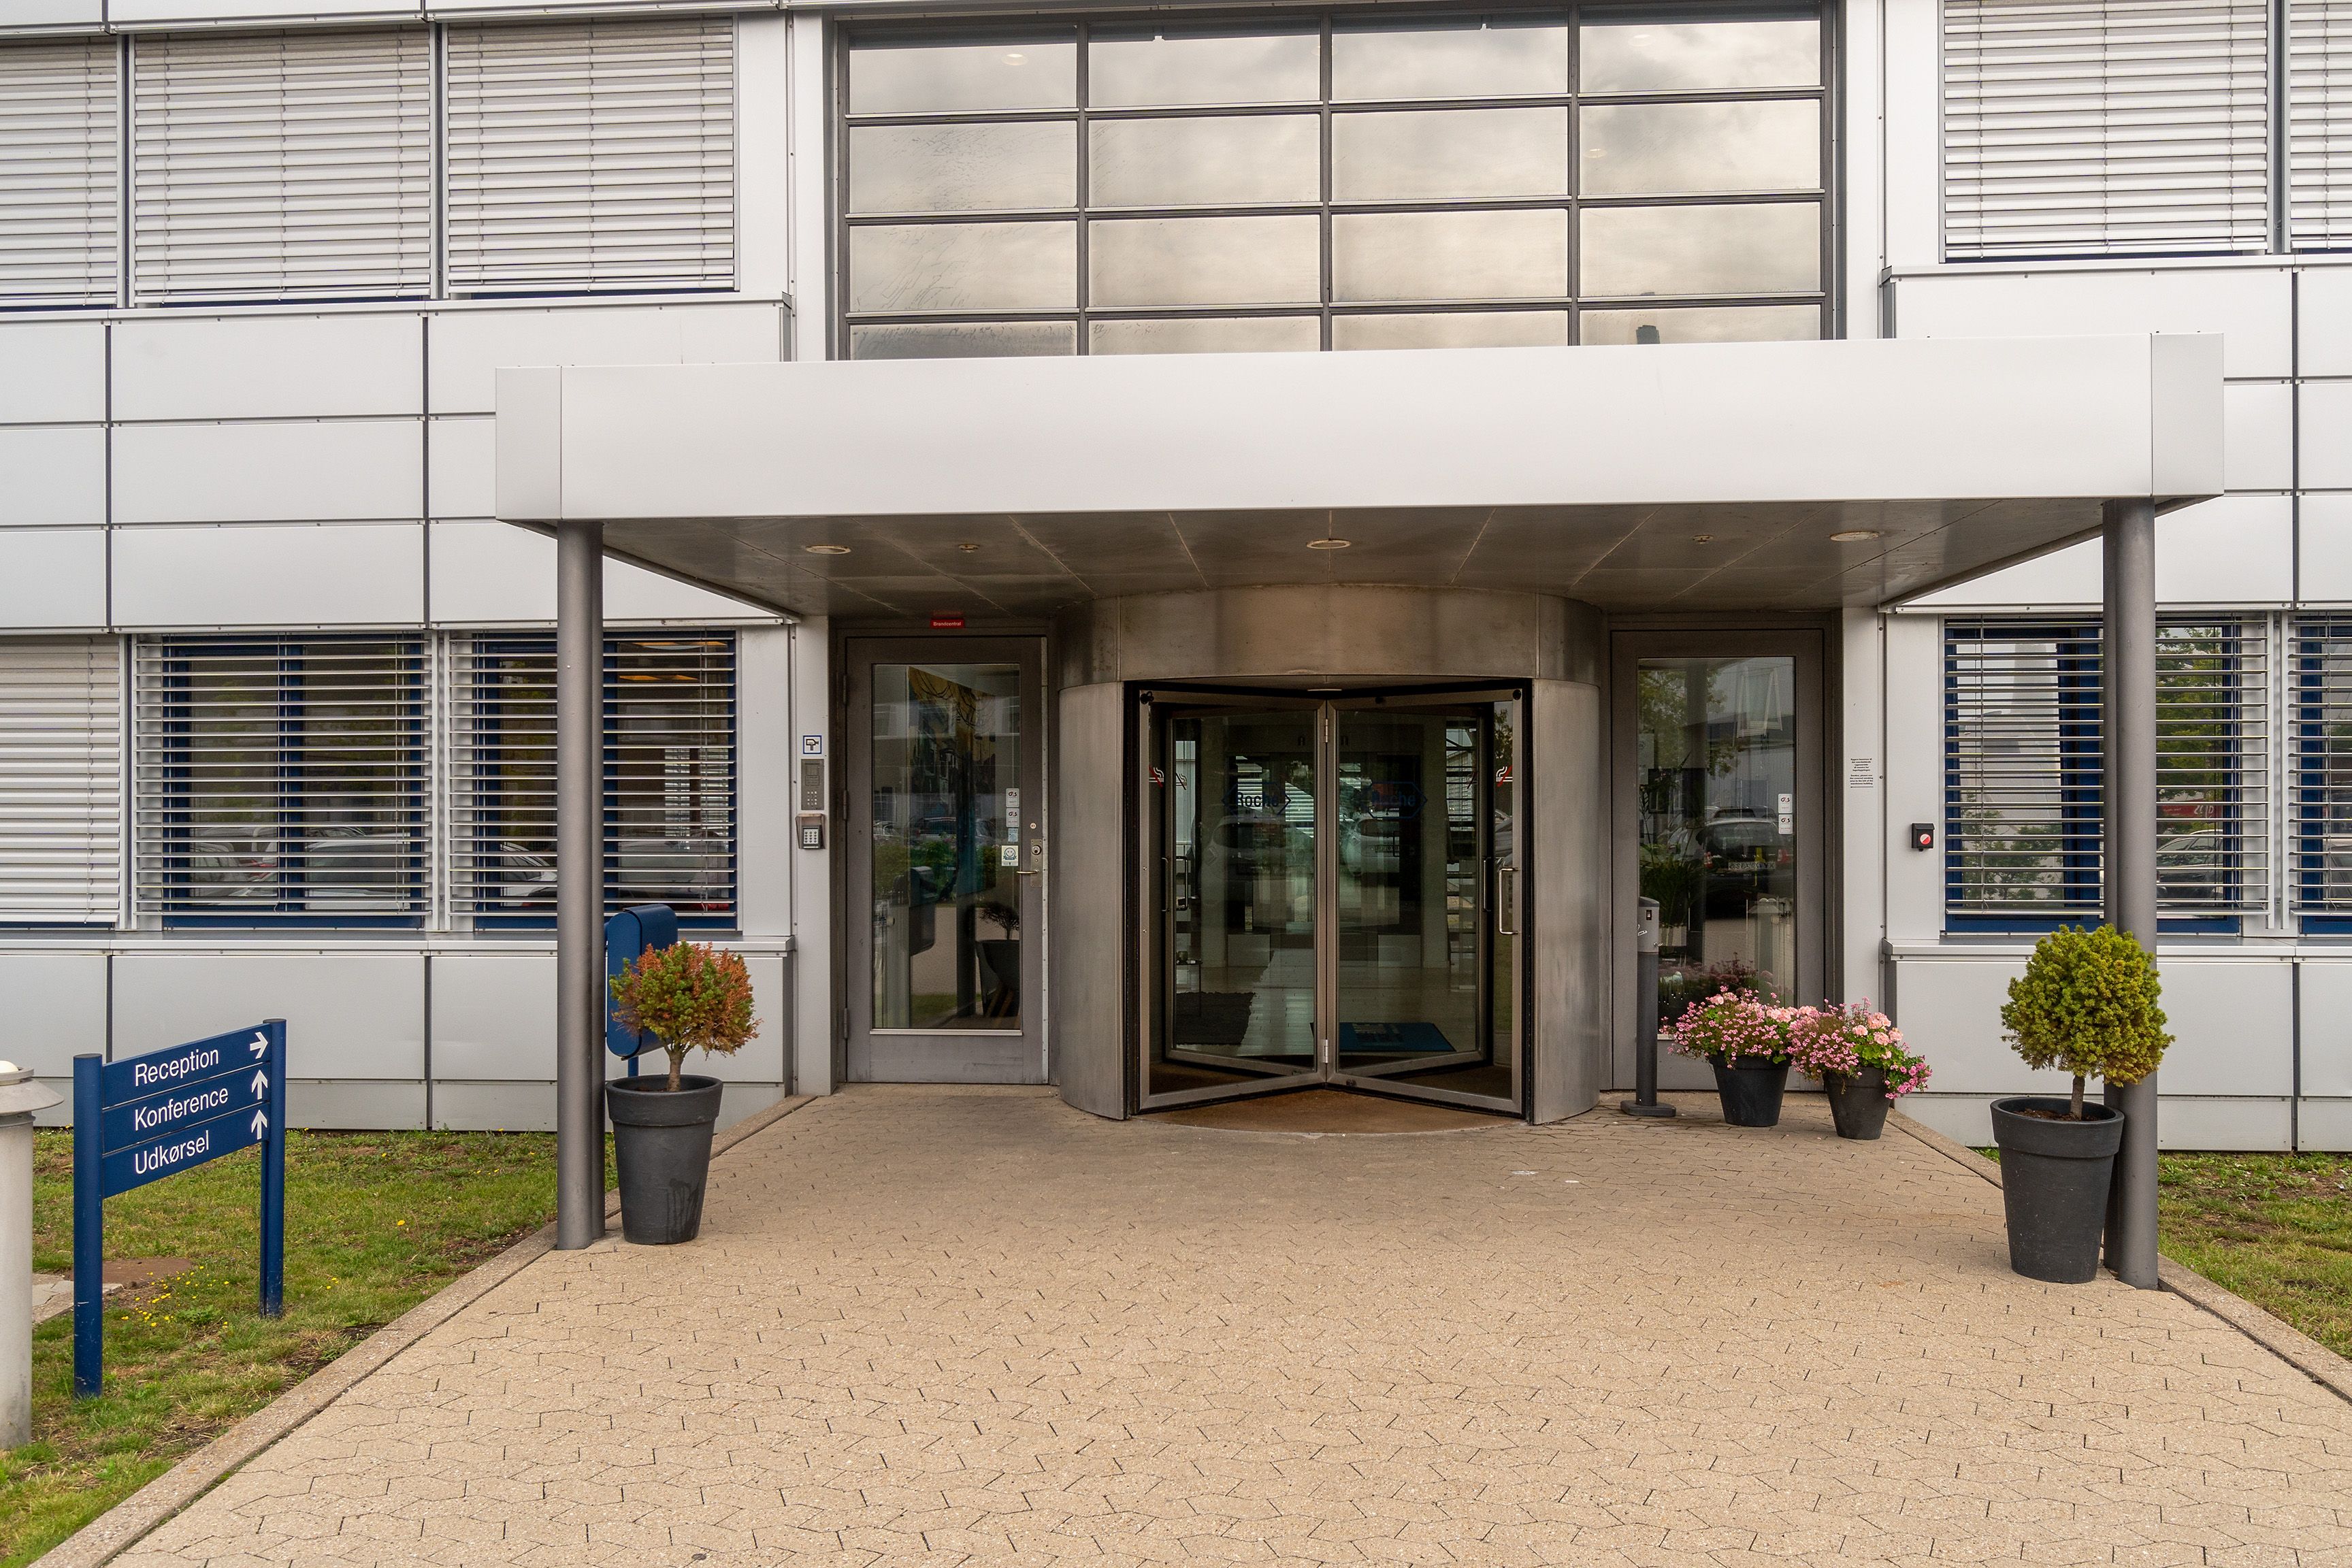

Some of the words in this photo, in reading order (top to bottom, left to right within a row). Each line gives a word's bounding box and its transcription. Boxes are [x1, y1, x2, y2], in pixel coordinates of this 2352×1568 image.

[135, 1049, 219, 1087] Reception
[135, 1088, 229, 1131] Konference
[135, 1130, 209, 1175] Udkørsel
